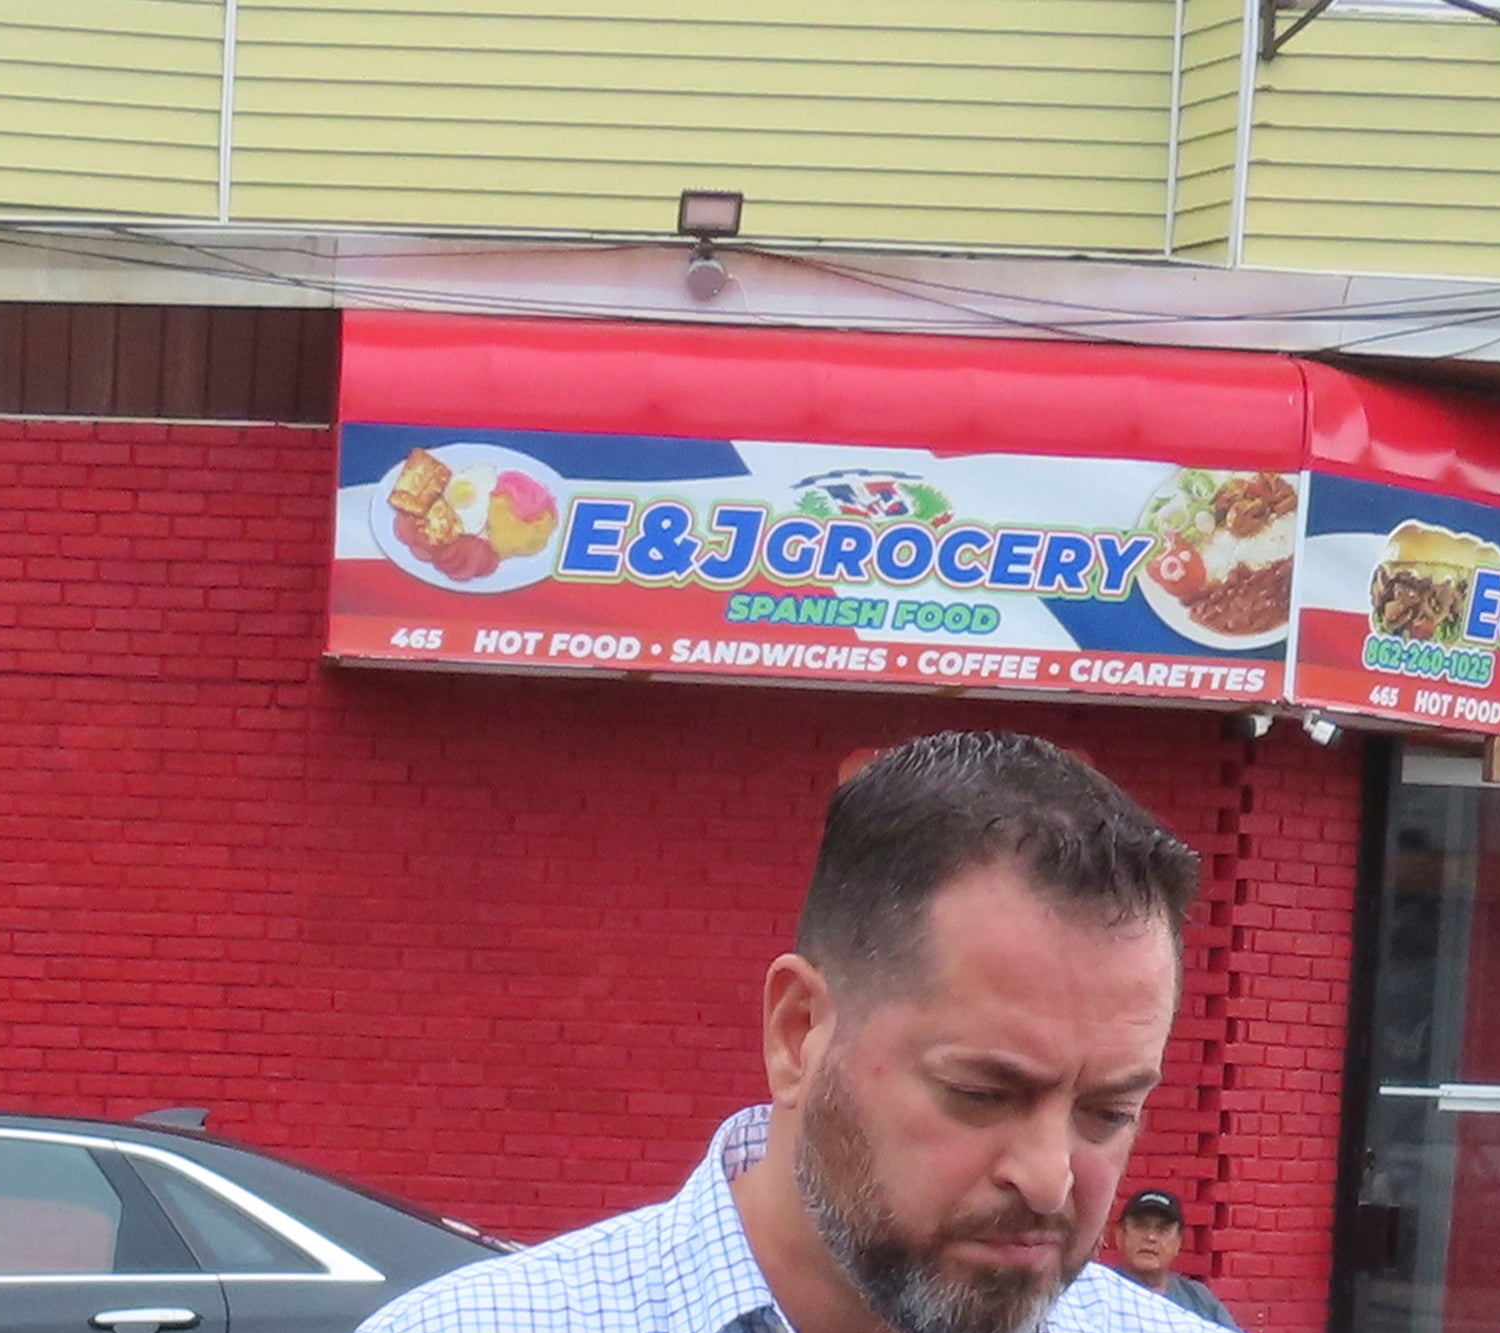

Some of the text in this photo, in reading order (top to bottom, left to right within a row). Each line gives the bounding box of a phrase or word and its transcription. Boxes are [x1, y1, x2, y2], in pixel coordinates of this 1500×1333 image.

[726, 591, 1001, 634] SPANISH FOOD
[390, 627, 1266, 693] 465 HOT FOOD SANDWICHES COFFEE CIGARETTES
[1366, 638, 1492, 683] 862-240-1025
[1369, 686, 1400, 708] 465
[1414, 690, 1454, 717] HOT
